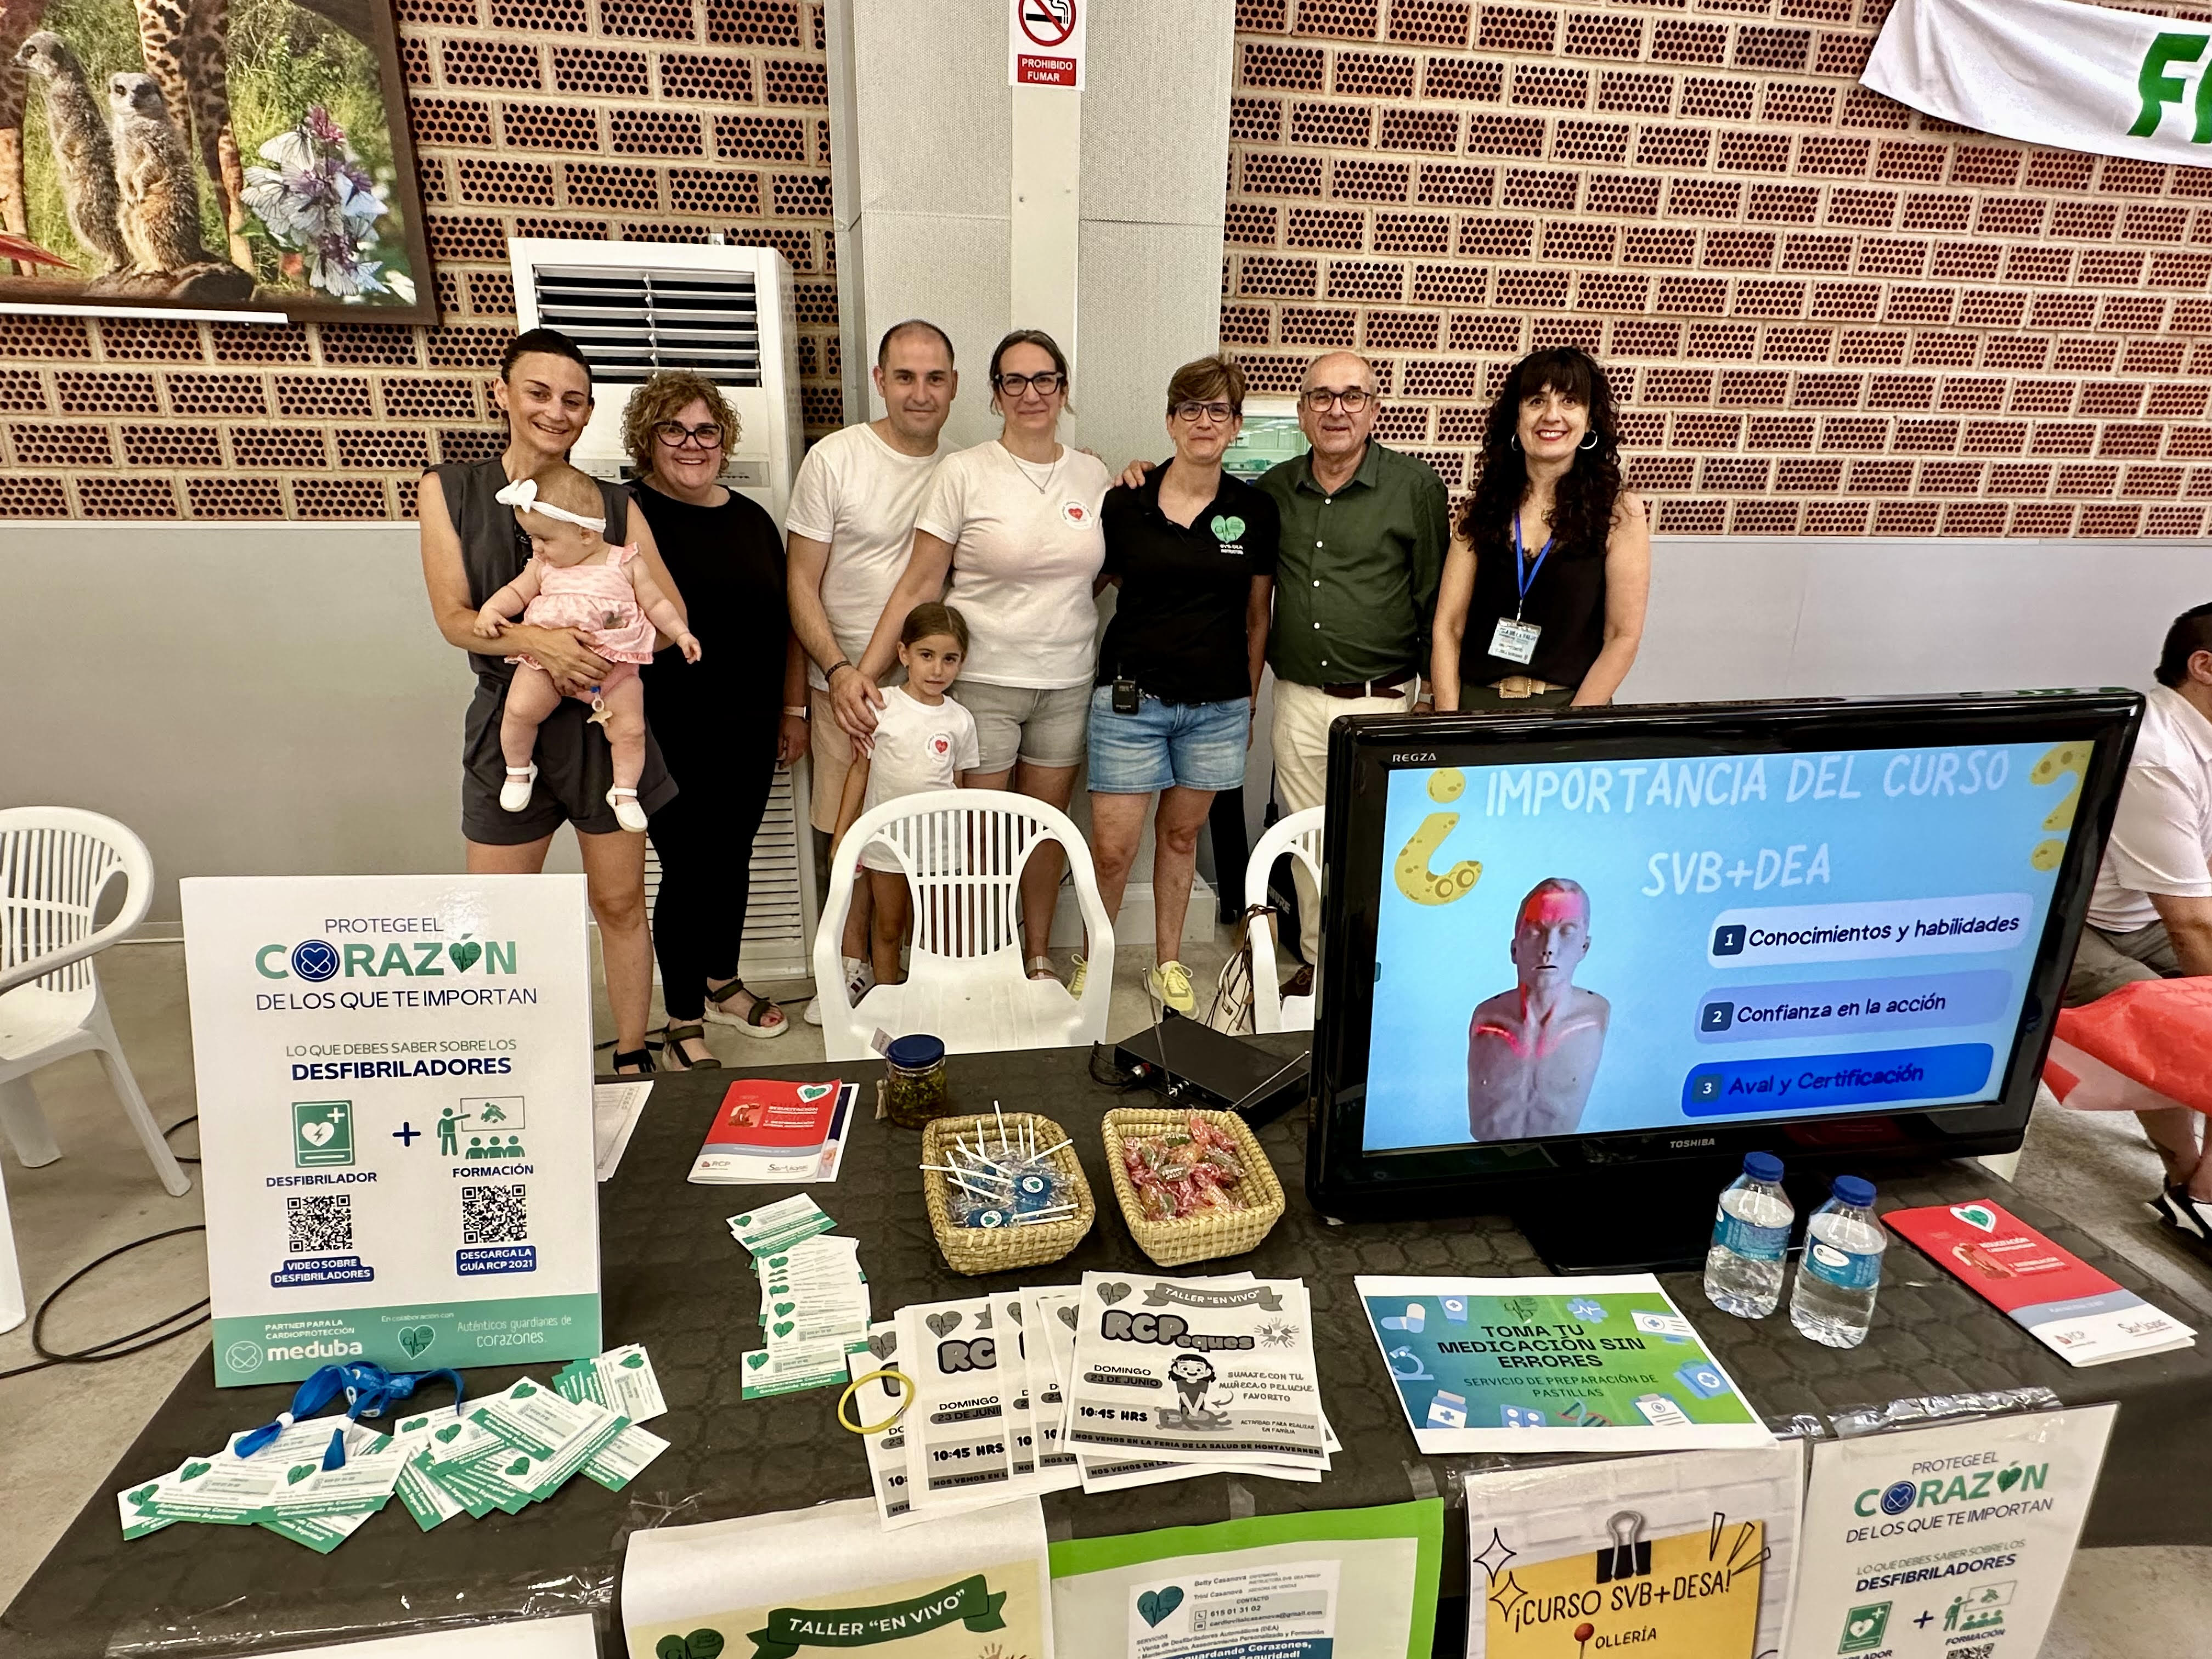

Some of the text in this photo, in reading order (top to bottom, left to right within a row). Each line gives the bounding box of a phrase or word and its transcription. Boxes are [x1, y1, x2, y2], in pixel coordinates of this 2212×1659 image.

[1022, 58, 1073, 70] PROHIBIDO
[1028, 71, 1060, 82] FUMAR
[1392, 753, 1437, 762] REGZA
[1486, 750, 2010, 816] IMPORTANCIA DEL CURSO
[1641, 843, 1830, 897] SVB+DEA
[325, 918, 444, 933] PROTEGE EL
[1724, 916, 2019, 947] 1 Conocimientos y habilidades
[256, 989, 537, 1010] DE LOS QUE TE IMPORTAN
[1712, 993, 1946, 1023] 2 Confianza en la acción
[286, 1039, 517, 1057] LO QUE DEBES SABER SOBRE LOS
[292, 1057, 511, 1080] DESFIBRILADORES
[1703, 1065, 1923, 1096] 3 Aval y Certificación
[1670, 1138, 1716, 1149] TOSHIBA
[453, 1164, 534, 1178] FORMACIÓN
[266, 1171, 377, 1187] DESFIBRILADOR
[287, 1259, 357, 1271] VIDEO SOBRE
[460, 1260, 533, 1271] GUÍA RCP 2021
[274, 1269, 370, 1283] DESFIBRILADORES
[1165, 1288, 1204, 1303] TALLER
[266, 1322, 305, 1331] PARTNER
[458, 1315, 572, 1333] Auténticos guardianes de
[1481, 1324, 1584, 1338] TOMA TU
[266, 1327, 354, 1339] CARDIOPROTECCIÓN
[268, 1339, 363, 1361] meduba
[1437, 1336, 1646, 1353] MEDICACIÓN SIN
[1498, 1355, 1602, 1368] ERRORES
[1094, 1365, 1151, 1375] DOMINGO
[1091, 1374, 1105, 1383] 23
[1124, 1378, 1159, 1386] JUNIO
[1463, 1375, 1658, 1387] SERVICIO DE PREPARACIÓN DE
[1270, 1383, 1314, 1392] PELUCHE
[1533, 1387, 1604, 1397] PASTILLAS
[939, 1396, 998, 1410] DOMINGO
[1243, 1393, 1290, 1402] FAVORITO
[938, 1413, 952, 1421] 23
[973, 1408, 1002, 1417] JUNI
[1080, 1407, 1148, 1421] 10:45 HRS
[933, 1443, 1005, 1462] 10:45 HRS
[1111, 1464, 1141, 1472] VEMOS
[1912, 1452, 1999, 1475] PROTEGE EL
[955, 1475, 985, 1484] VEMOS
[1846, 1498, 2053, 1543] DE LOS QUE TE IMPORTAN
[1857, 1539, 2026, 1575] LO QUE DEBES SABER SOBRE LOS
[1214, 1575, 1246, 1584] Casanova
[1855, 1554, 2017, 1592] DESFIBRILADORES
[1210, 1589, 1243, 1598] Casanova
[1237, 1595, 1269, 1604] CONTACTO
[1515, 1569, 1731, 1632] ¡CURSO SVB+DESA!
[789, 1617, 864, 1635] TALLER
[1595, 1626, 1657, 1649] OLLERÍA
[1945, 1629, 2006, 1645] FORMACIÓN
[1249, 1640, 1311, 1652] Corazones,
